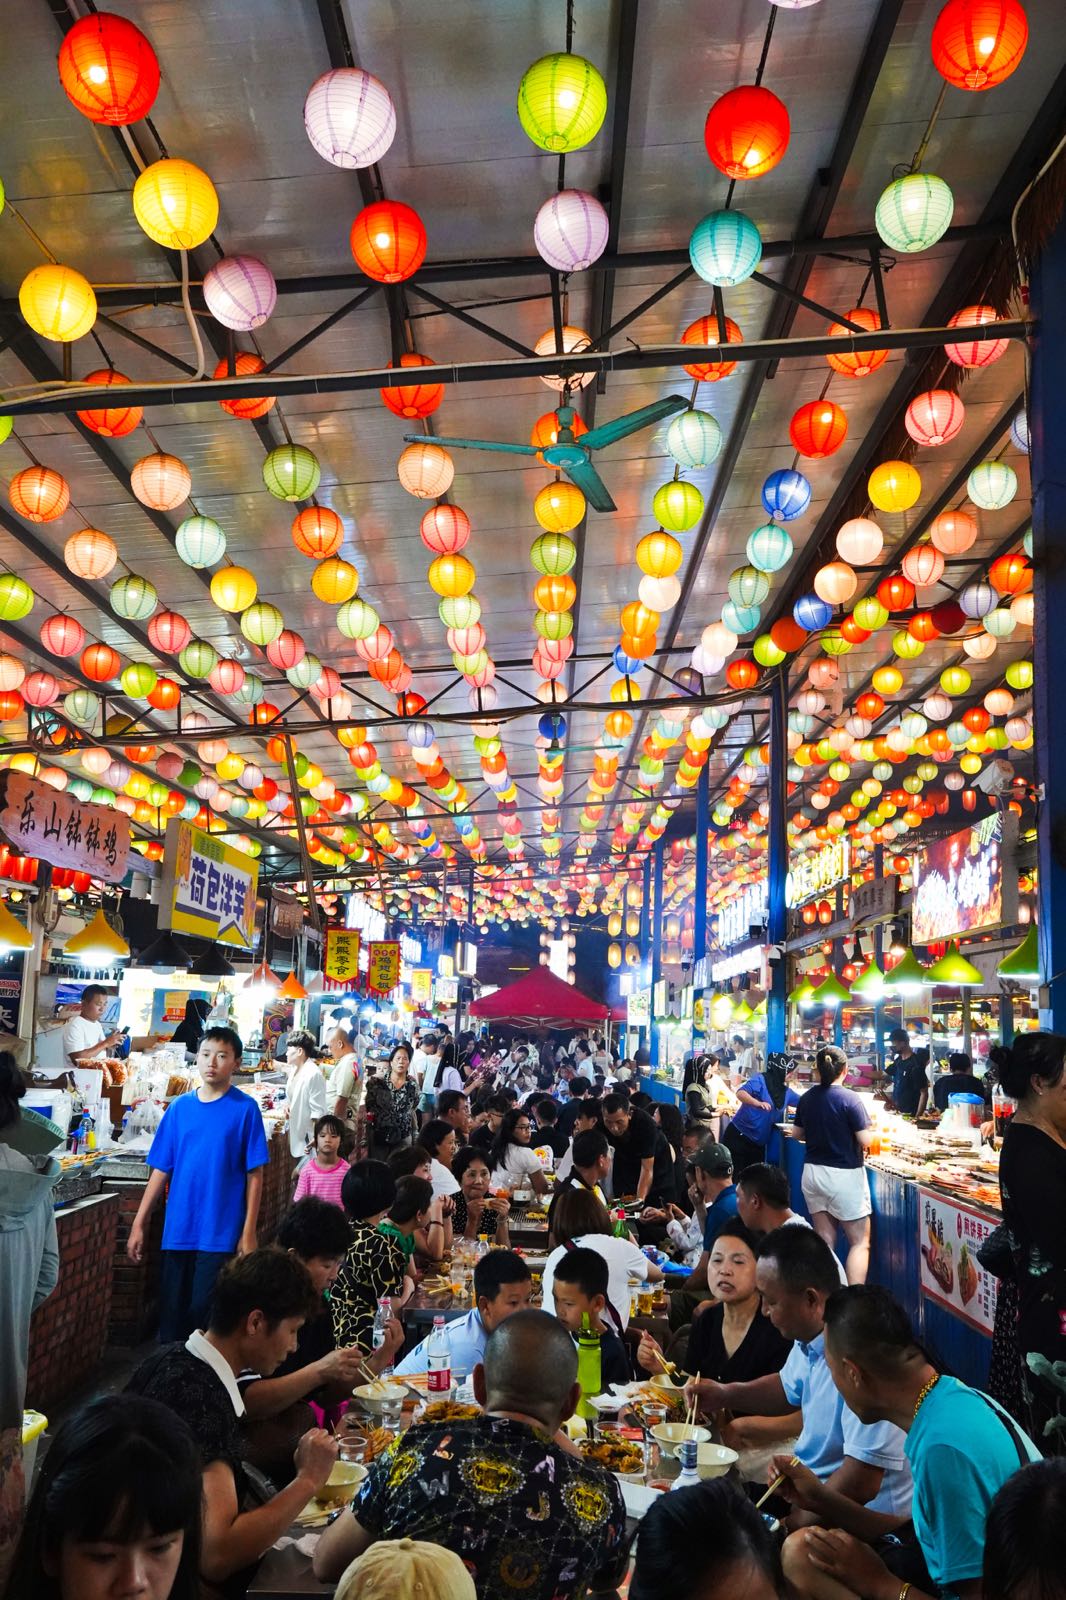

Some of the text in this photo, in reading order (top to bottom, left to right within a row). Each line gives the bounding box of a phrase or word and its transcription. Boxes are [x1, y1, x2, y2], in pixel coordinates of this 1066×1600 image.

[20, 790, 117, 866] 乐山钵钵鸡
